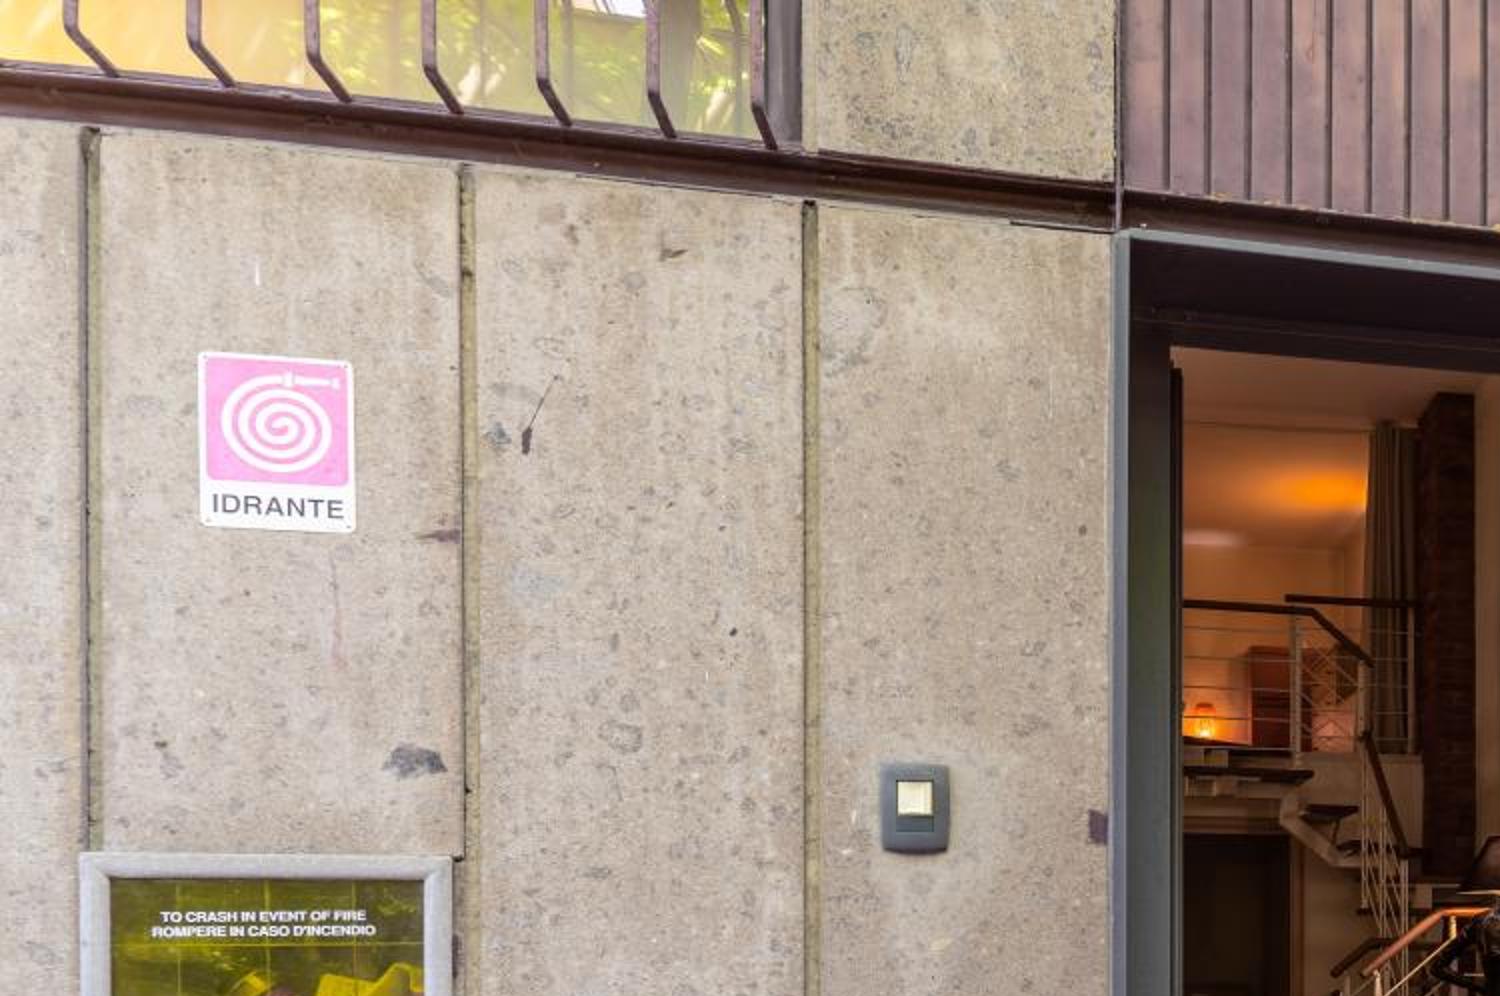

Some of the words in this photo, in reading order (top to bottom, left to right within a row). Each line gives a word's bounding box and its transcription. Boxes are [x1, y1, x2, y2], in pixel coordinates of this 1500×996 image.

[212, 493, 345, 519] IDRANTE
[160, 911, 182, 923] TO
[185, 911, 237, 923] CRASH
[241, 911, 255, 922] IN
[259, 910, 307, 922] EVENT
[310, 910, 330, 921] OF
[333, 909, 367, 921] FIRE
[152, 925, 226, 938] ROMPERE
[229, 926, 244, 937] IN
[248, 925, 290, 937] CASO
[293, 924, 377, 936] D'INCENDIO
